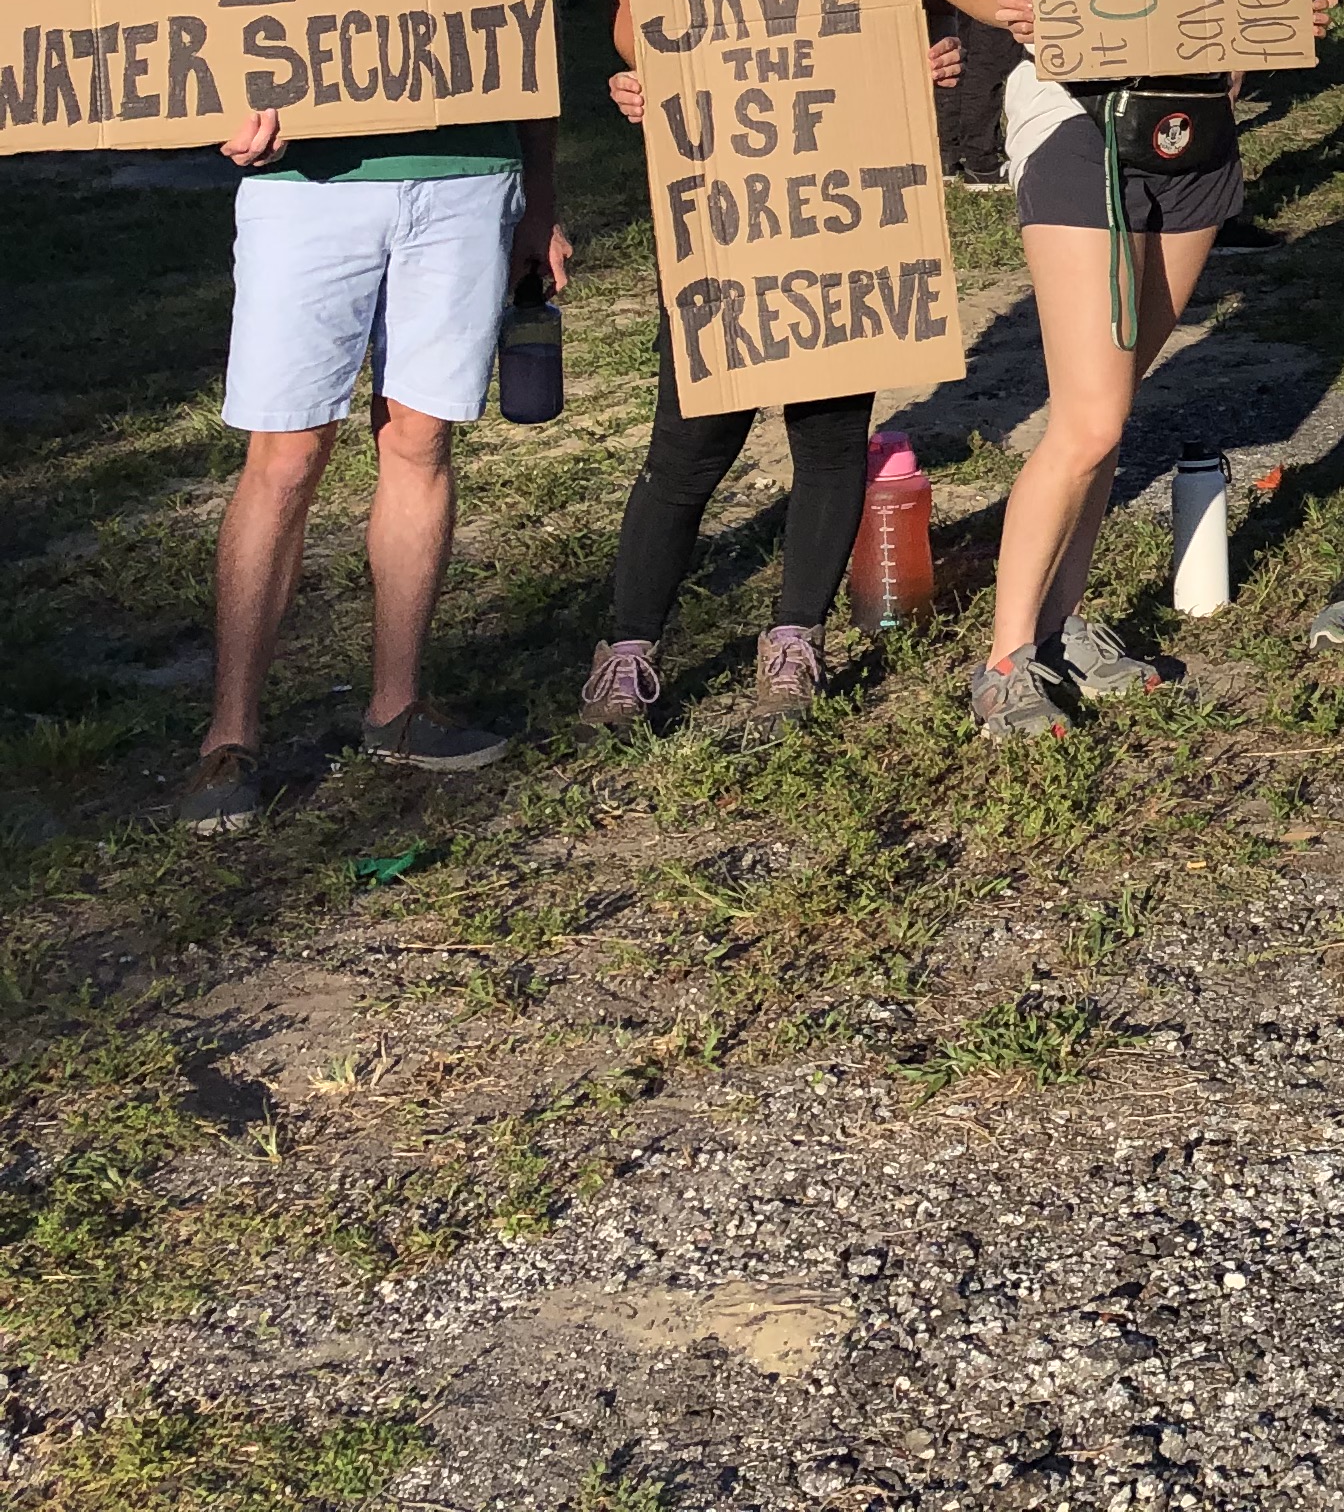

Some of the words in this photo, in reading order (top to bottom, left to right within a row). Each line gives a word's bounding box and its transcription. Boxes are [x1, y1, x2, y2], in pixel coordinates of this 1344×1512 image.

[721, 39, 815, 82] THE
[659, 87, 836, 162] USF
[666, 163, 928, 263] FOREST
[674, 257, 948, 384] PRESERVE
